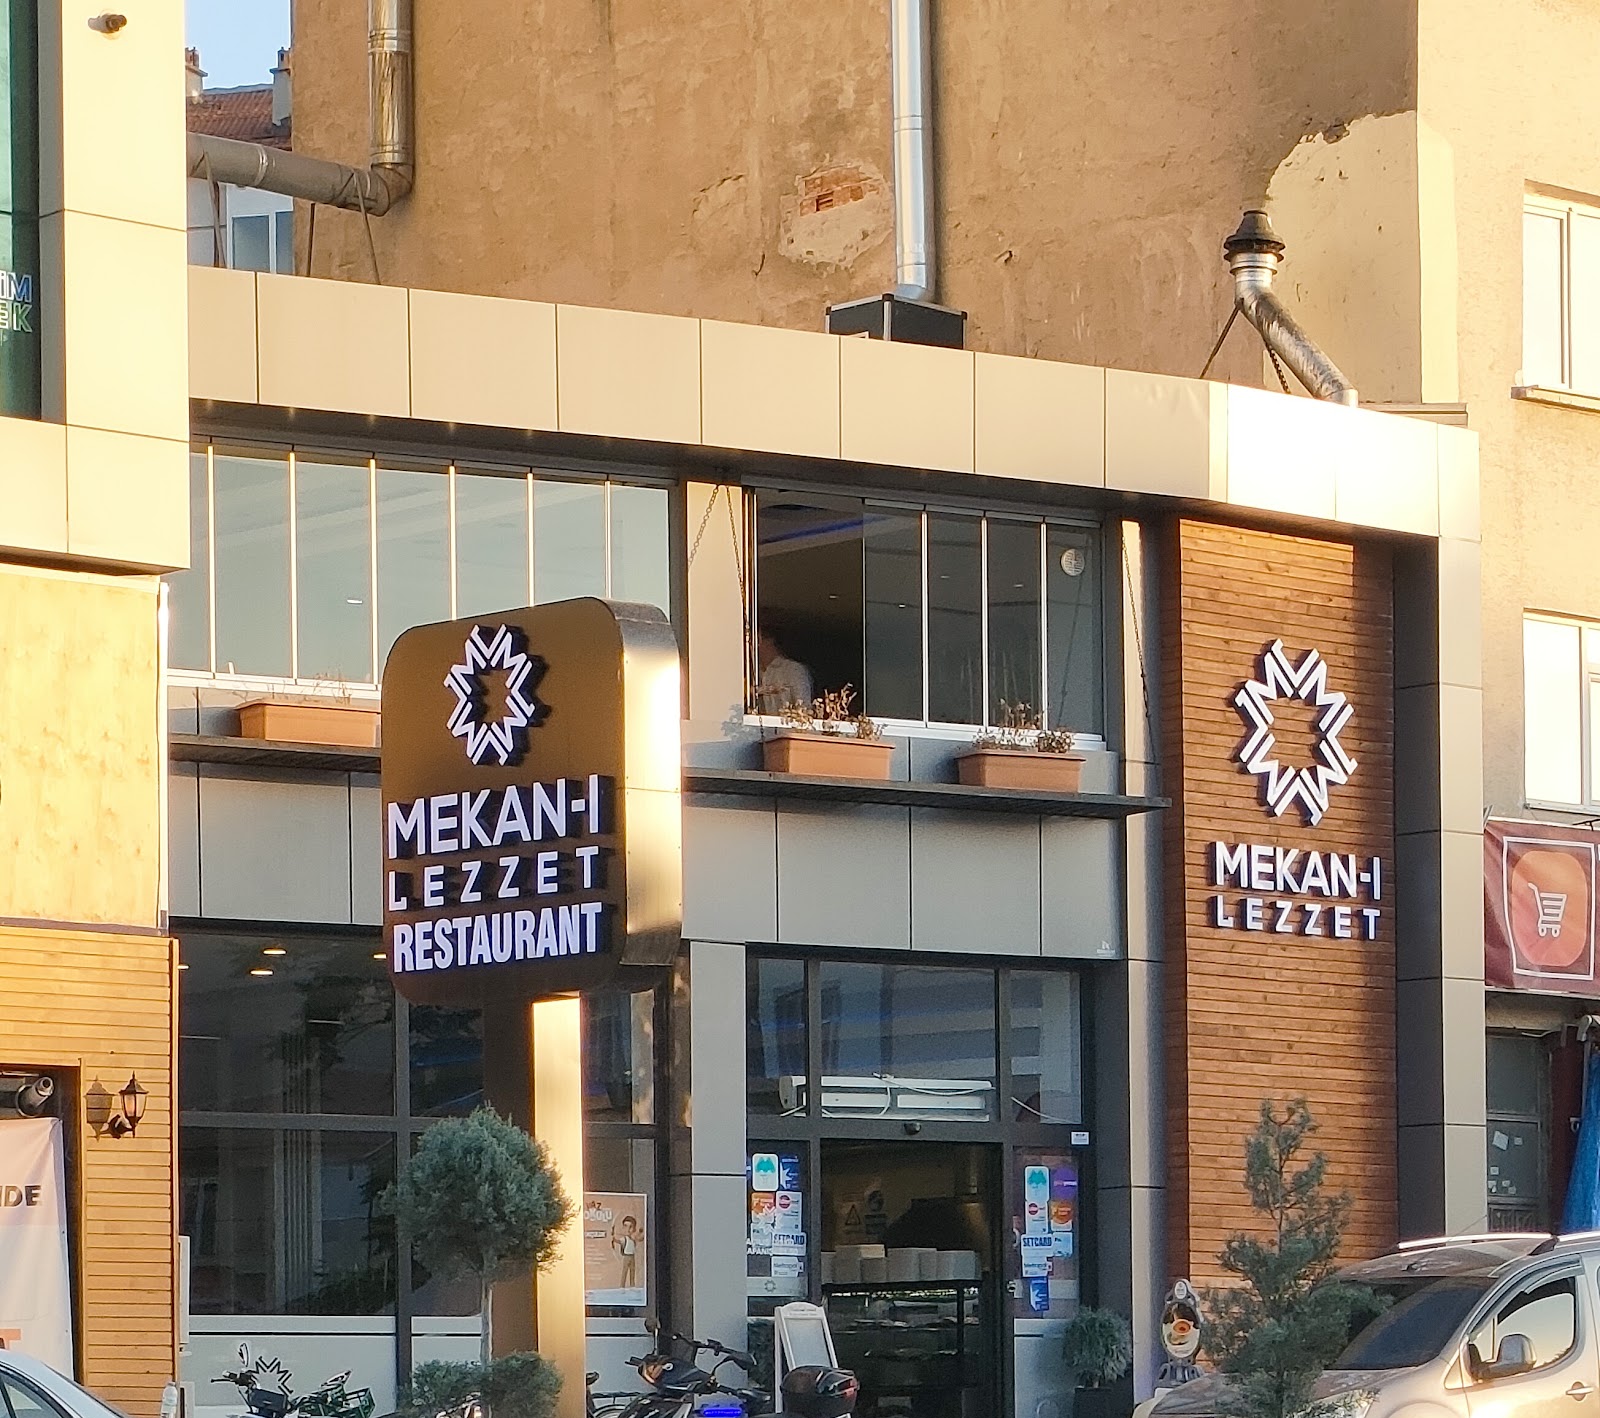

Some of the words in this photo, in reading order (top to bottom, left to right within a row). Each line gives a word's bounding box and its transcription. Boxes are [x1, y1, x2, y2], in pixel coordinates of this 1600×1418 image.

[387, 773, 599, 860] MEKAN-I
[388, 845, 599, 912] LEZZET
[1214, 840, 1381, 901] MEKAN-I
[393, 901, 603, 974] RESTAURANT
[1216, 894, 1381, 941] LEZZET
[1022, 1236, 1053, 1247] SETCARD
